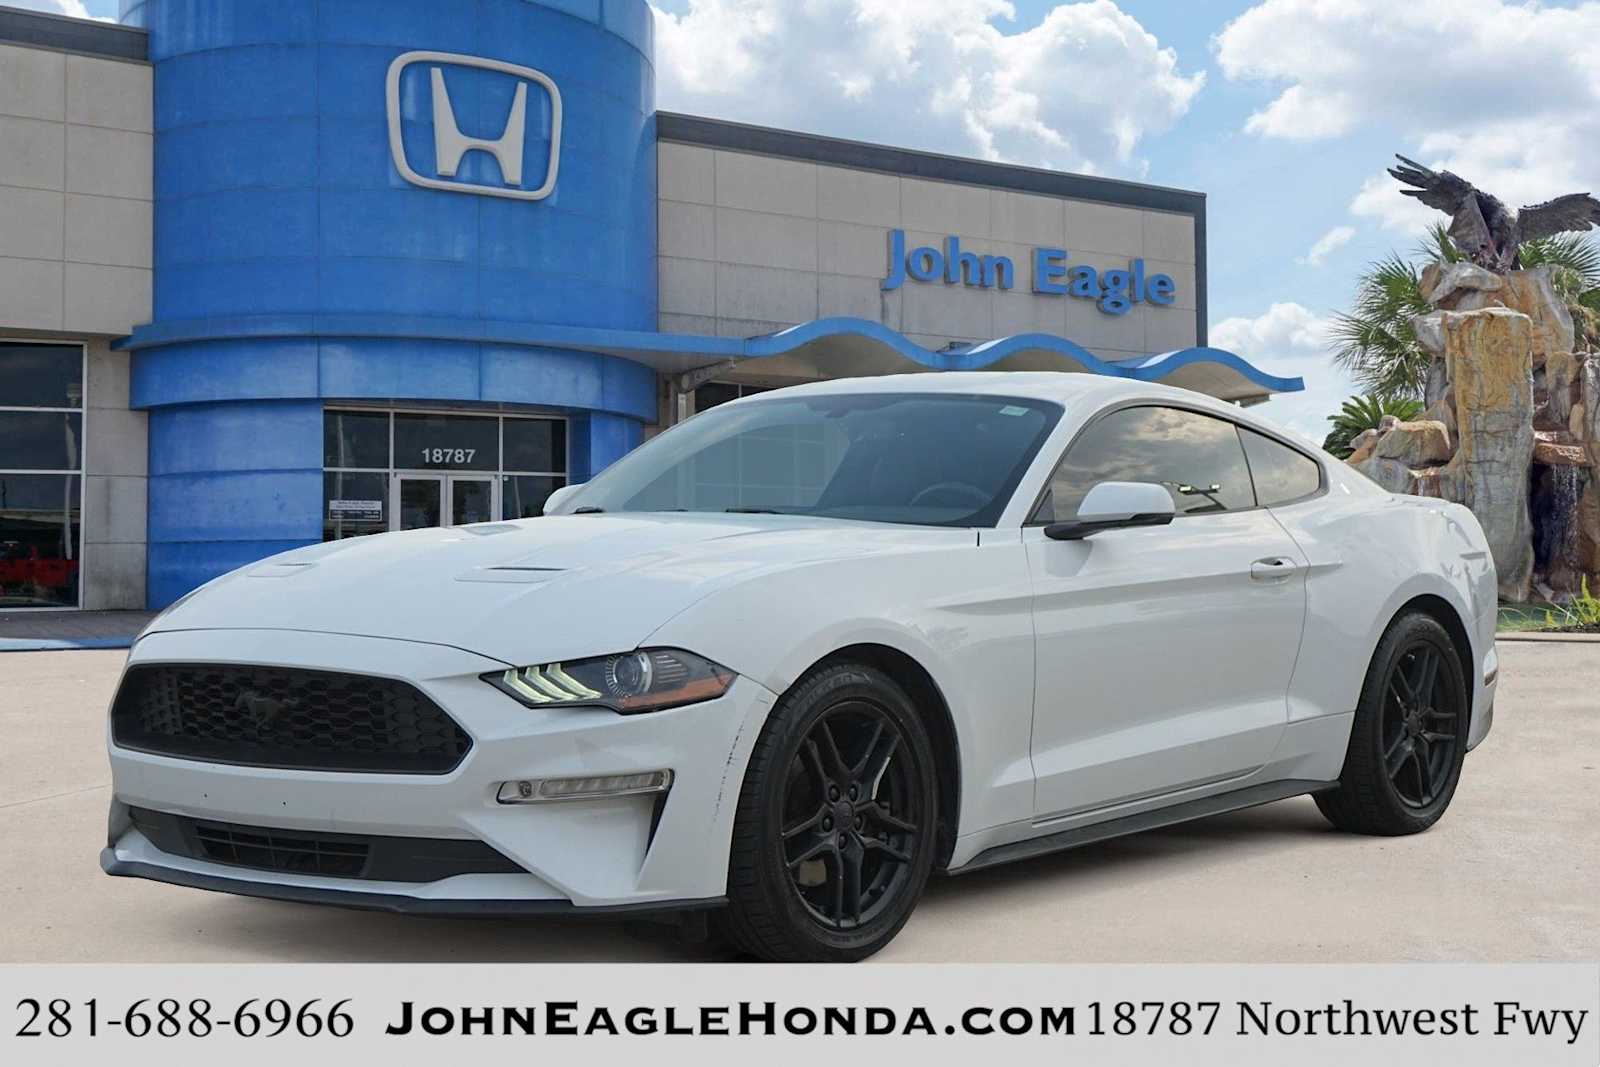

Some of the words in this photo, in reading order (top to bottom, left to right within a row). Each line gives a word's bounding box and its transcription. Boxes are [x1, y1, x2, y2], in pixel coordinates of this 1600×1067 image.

[881, 228, 1014, 291] John
[1032, 247, 1176, 316] Eagle
[422, 448, 476, 464] 18787
